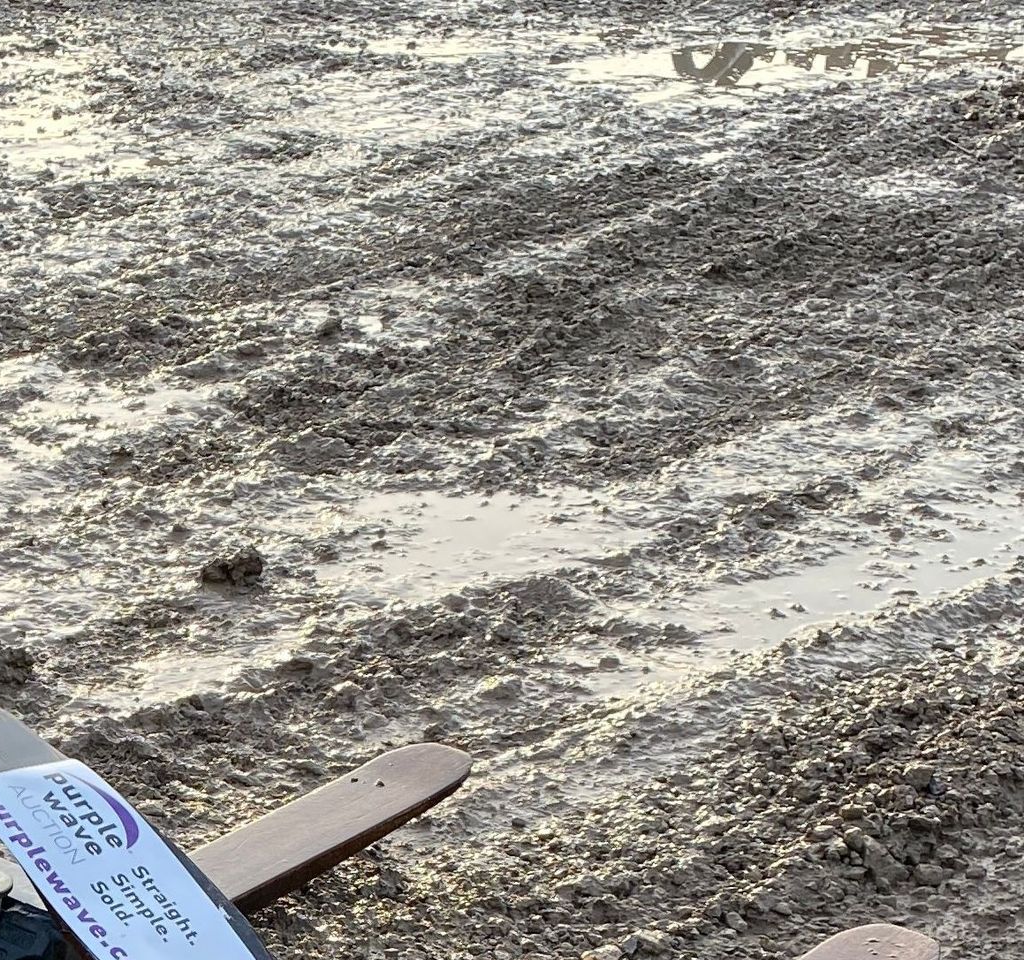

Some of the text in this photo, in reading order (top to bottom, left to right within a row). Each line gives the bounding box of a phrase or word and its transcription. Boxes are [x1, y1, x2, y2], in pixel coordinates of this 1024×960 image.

[8, 785, 85, 866] AUCTION
[43, 790, 102, 856] wave
[44, 772, 123, 849] purple
[90, 880, 130, 927] Sold.
[111, 873, 168, 943] Simple.
[131, 865, 196, 946] Straight.
